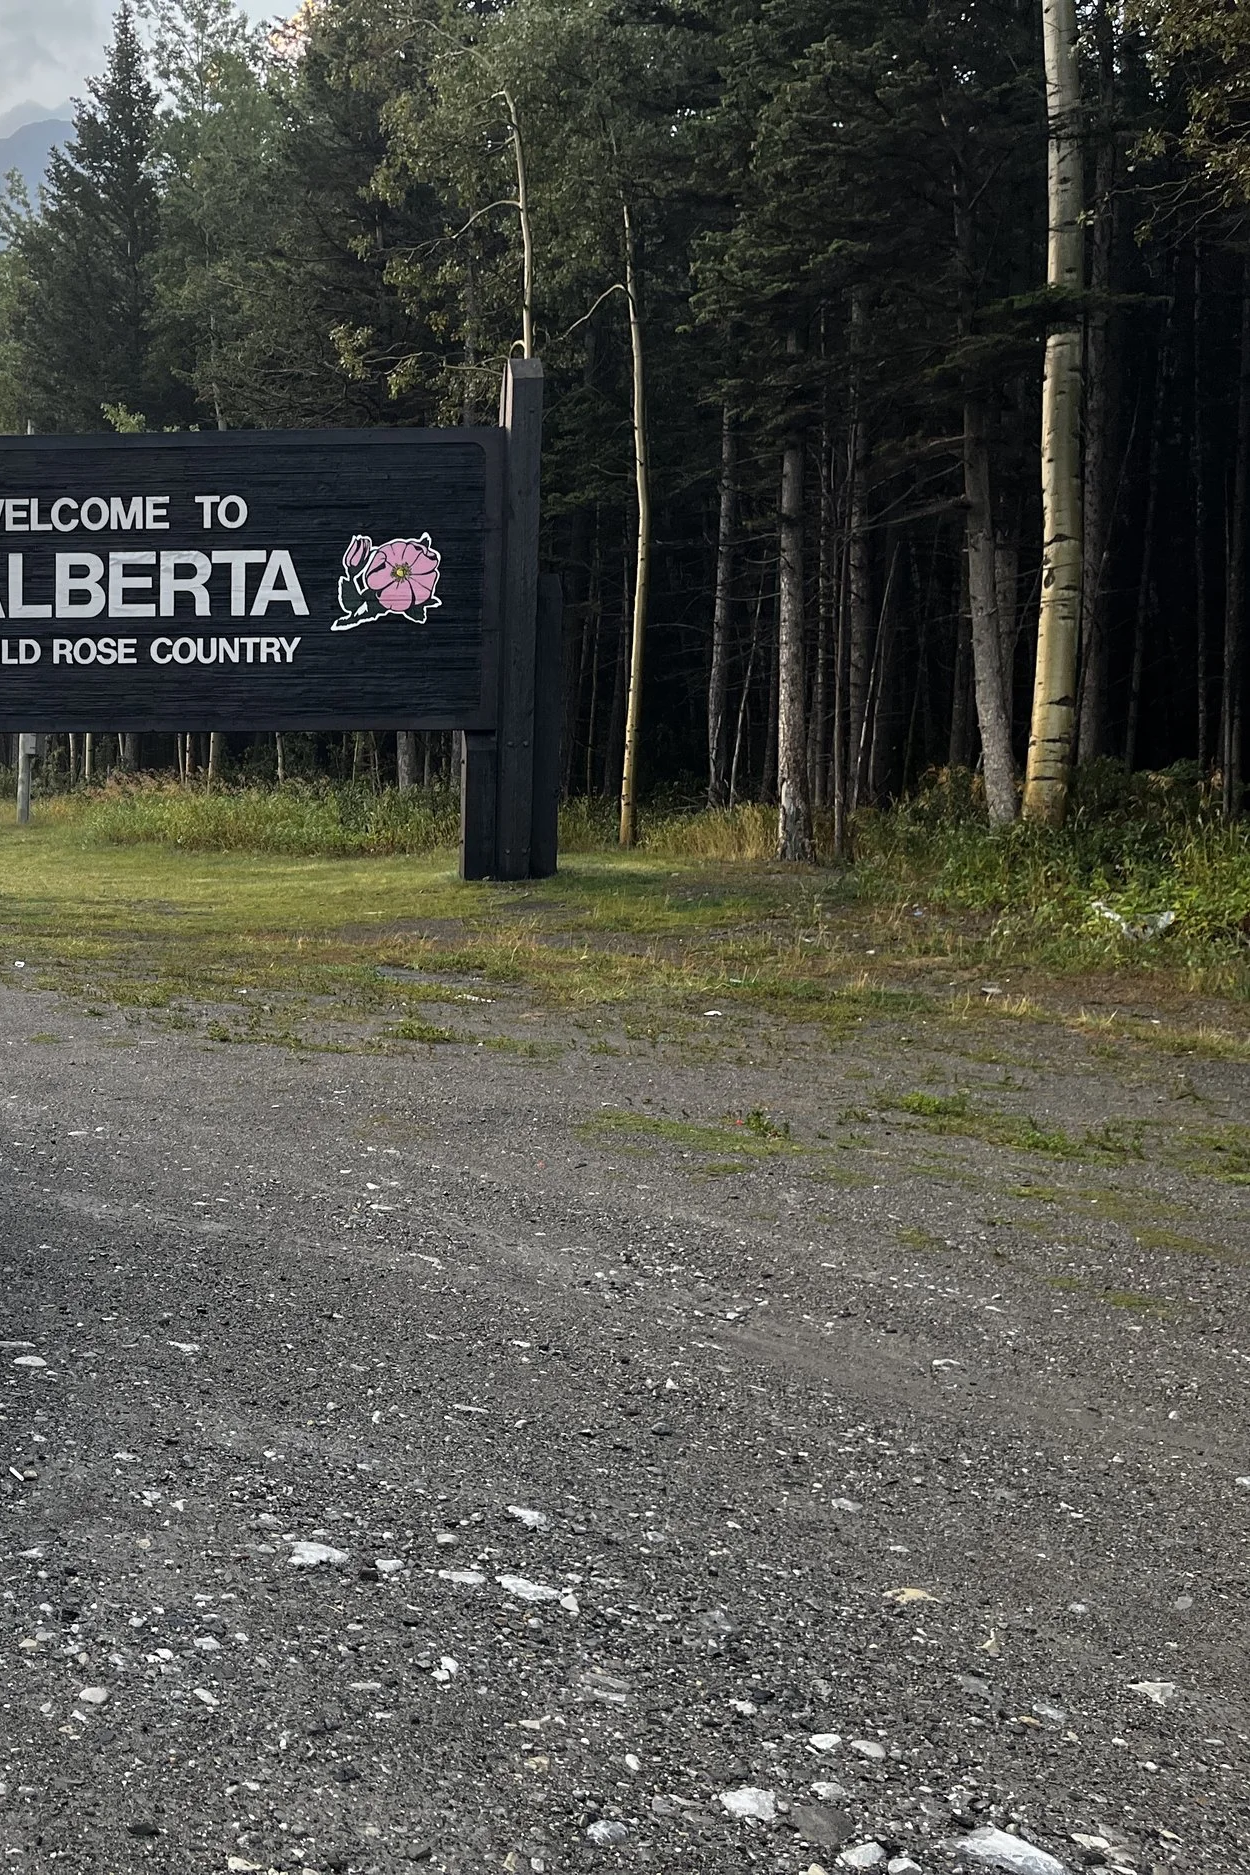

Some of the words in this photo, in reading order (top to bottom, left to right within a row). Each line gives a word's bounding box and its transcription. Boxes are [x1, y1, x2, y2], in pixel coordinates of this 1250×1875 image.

[195, 495, 248, 529] TO
[53, 637, 137, 665] ROSE
[150, 636, 302, 664] COUNTRY
